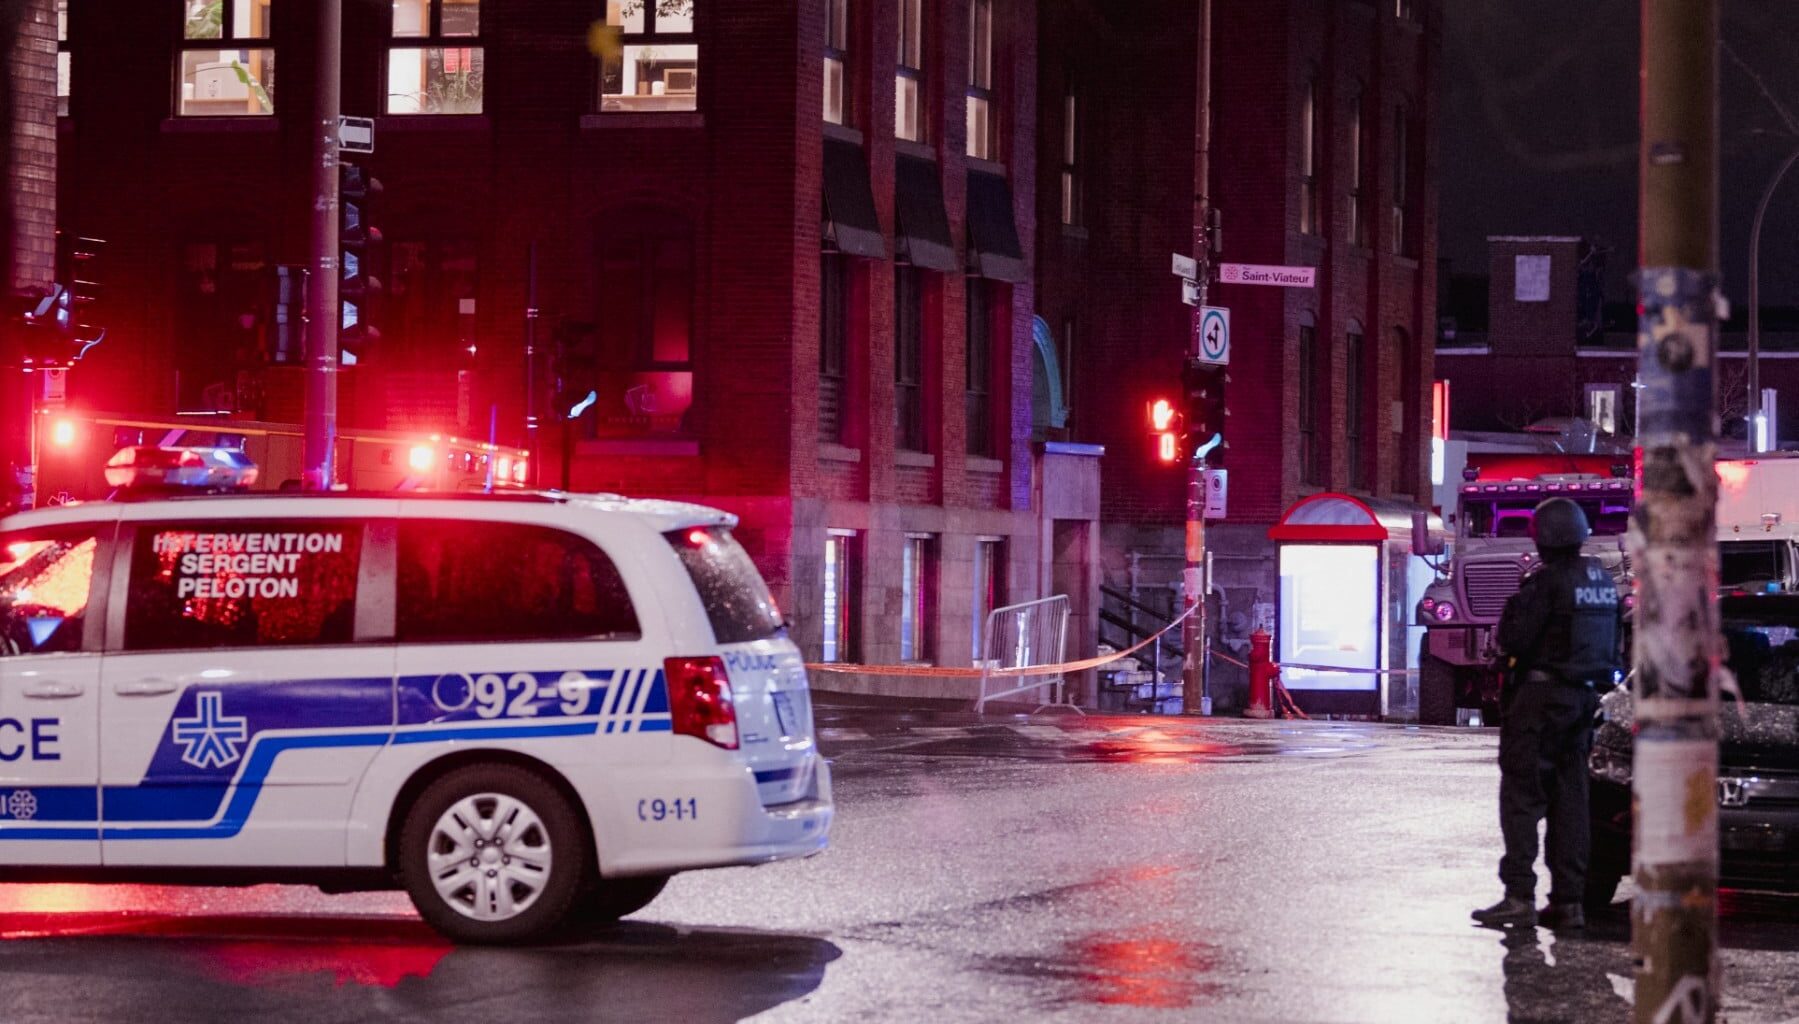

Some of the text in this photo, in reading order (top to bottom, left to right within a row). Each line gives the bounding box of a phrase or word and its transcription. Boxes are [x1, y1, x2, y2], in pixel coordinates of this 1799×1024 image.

[1241, 270, 1310, 284] Saint-Viateur
[152, 533, 343, 553] INTERVENTION
[180, 553, 301, 574] SERGENT
[177, 577, 298, 598] PELOTON
[1575, 587, 1618, 605] POLICE
[475, 671, 591, 718] 92-9
[0, 718, 61, 762] CE
